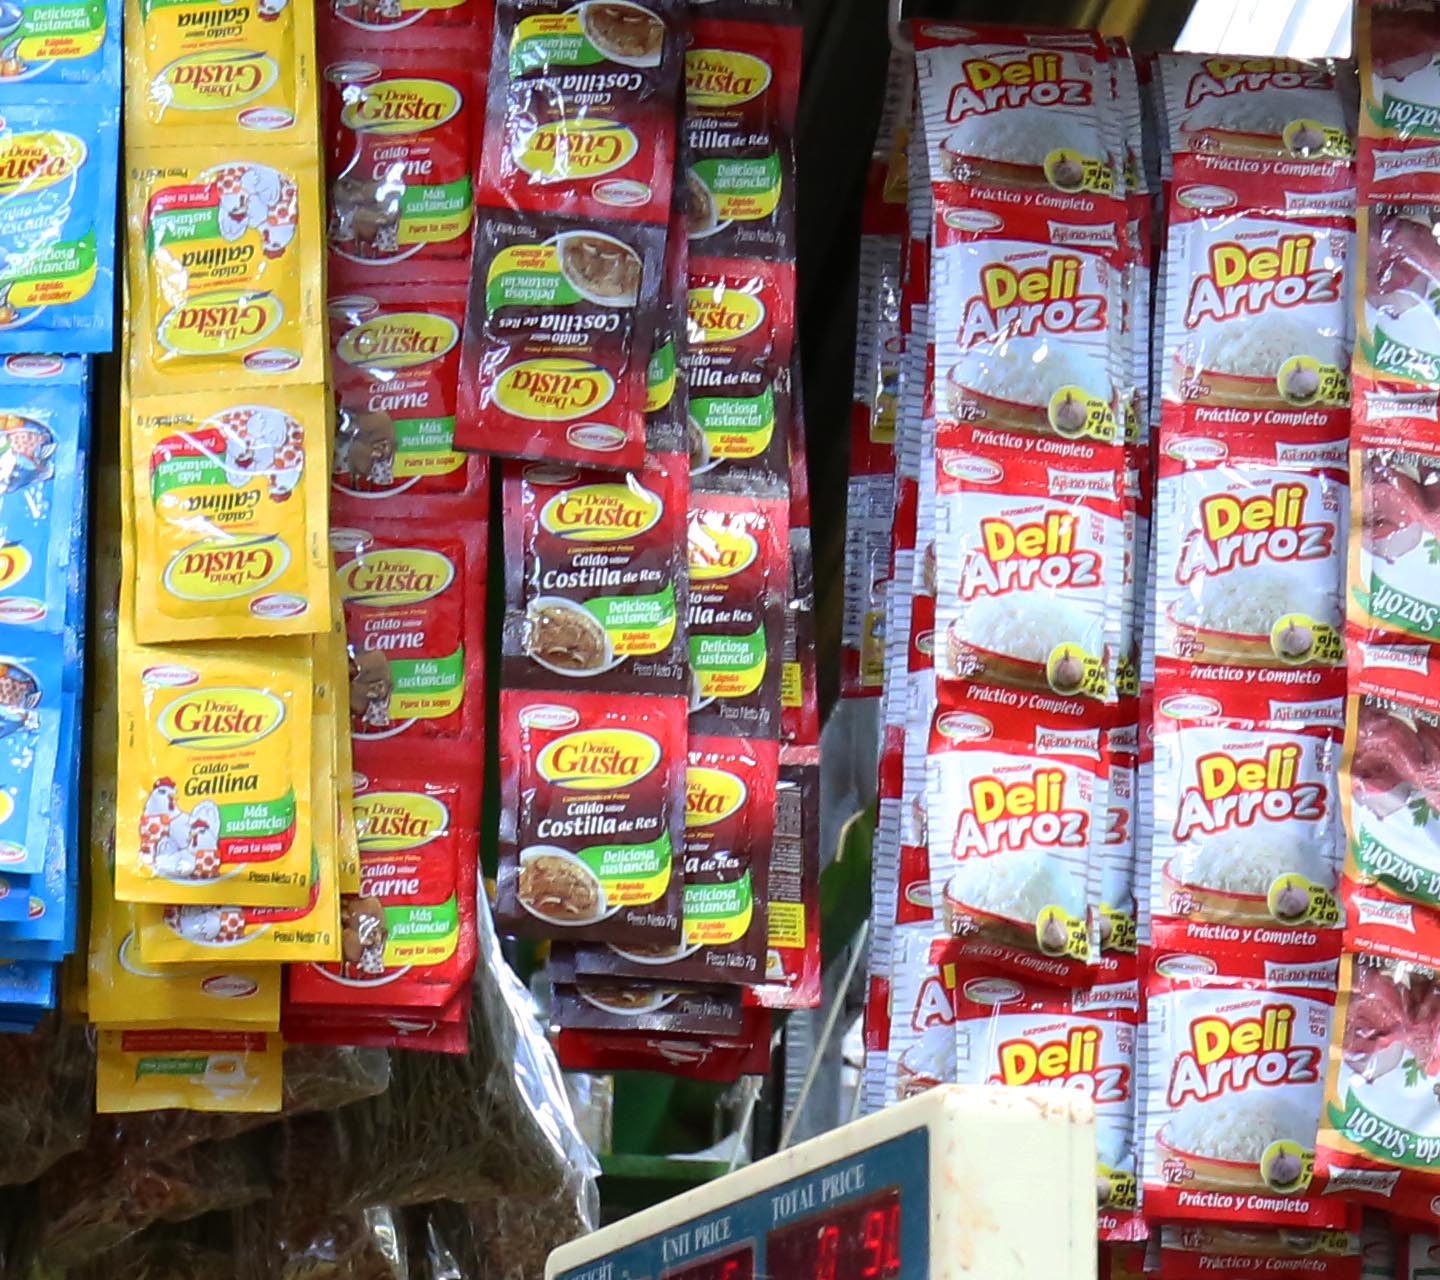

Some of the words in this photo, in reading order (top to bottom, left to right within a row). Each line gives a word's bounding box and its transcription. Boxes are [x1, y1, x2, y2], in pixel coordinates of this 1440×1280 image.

[177, 9, 251, 28] Gallina
[175, 63, 265, 89] Gusta
[562, 72, 643, 91] Costilla
[965, 54, 1064, 92] Deli
[946, 75, 1094, 123] Arroz
[1273, 161, 1338, 178] Completo
[969, 187, 1021, 204] Práctico
[1035, 193, 1095, 212] Completo
[182, 245, 255, 267] Gallina
[1210, 235, 1315, 288] Deli
[981, 256, 1084, 308] Deli
[1185, 269, 1344, 328] Arroz
[177, 306, 267, 331] Gusta
[539, 314, 620, 332] Costilla
[959, 299, 1110, 348] Arroz
[368, 379, 405, 393] Caldo
[510, 369, 600, 400] Gusta
[368, 391, 429, 412] Carne
[707, 402, 758, 415] Deliciosa
[703, 413, 762, 427] sustancia!
[1193, 407, 1249, 424] Práctico
[1251, 411, 1261, 425] y
[1264, 410, 1328, 426] Completo
[970, 429, 1024, 449] Práctico
[1025, 438, 1034, 454] y
[1035, 439, 1095, 460] Completo
[186, 489, 262, 512] Gallina
[1201, 484, 1307, 540] Deli
[555, 497, 646, 530] Gusta
[981, 512, 1079, 563] Deli
[182, 548, 276, 574] Gusta
[571, 552, 608, 567] Caldo
[1177, 523, 1338, 583] Arroz
[348, 565, 436, 593] Gusta
[543, 567, 621, 589] Costilla
[622, 571, 637, 583] de
[639, 568, 661, 583] Res
[959, 551, 1105, 599] Arroz
[364, 618, 400, 632] Caldo
[364, 630, 425, 651] Carne
[1190, 665, 1244, 681] Práctico
[1247, 669, 1255, 684] y
[1258, 669, 1321, 685] Completo
[966, 685, 1020, 706] Práctico
[1030, 697, 1085, 716] Completo
[174, 703, 263, 733] Gusta
[192, 764, 229, 775] Caldo
[551, 745, 639, 776] Gusta
[1199, 744, 1303, 799] Deli
[185, 774, 258, 796] Gallina
[969, 768, 1065, 822] Deli
[243, 806, 268, 817] Más
[567, 803, 604, 815] Caldo
[1173, 785, 1327, 842] Arroz
[537, 816, 616, 838] Costilla
[618, 821, 633, 832] de
[635, 817, 657, 830] Res
[952, 809, 1089, 859] Arroz
[600, 860, 660, 875] sustancia!
[603, 849, 655, 864] Deliciosa
[701, 861, 715, 871] de
[358, 876, 419, 897] Carne
[1186, 923, 1239, 941] Práctico
[1240, 928, 1250, 946] y
[1253, 928, 1317, 946] Completo
[1192, 1005, 1293, 1063] Deli
[998, 1026, 1099, 1085] Deli
[1168, 1047, 1320, 1106] Arroz
[771, 1187, 814, 1221] TOTAL
[821, 1164, 865, 1200] PRICE
[1177, 1191, 1233, 1209] Práctico
[1234, 1197, 1244, 1213] y
[1245, 1194, 1310, 1214] Completo
[694, 1215, 732, 1250] PRICE
[1199, 1255, 1251, 1269] Práctico
[1265, 1258, 1328, 1272] Completo
